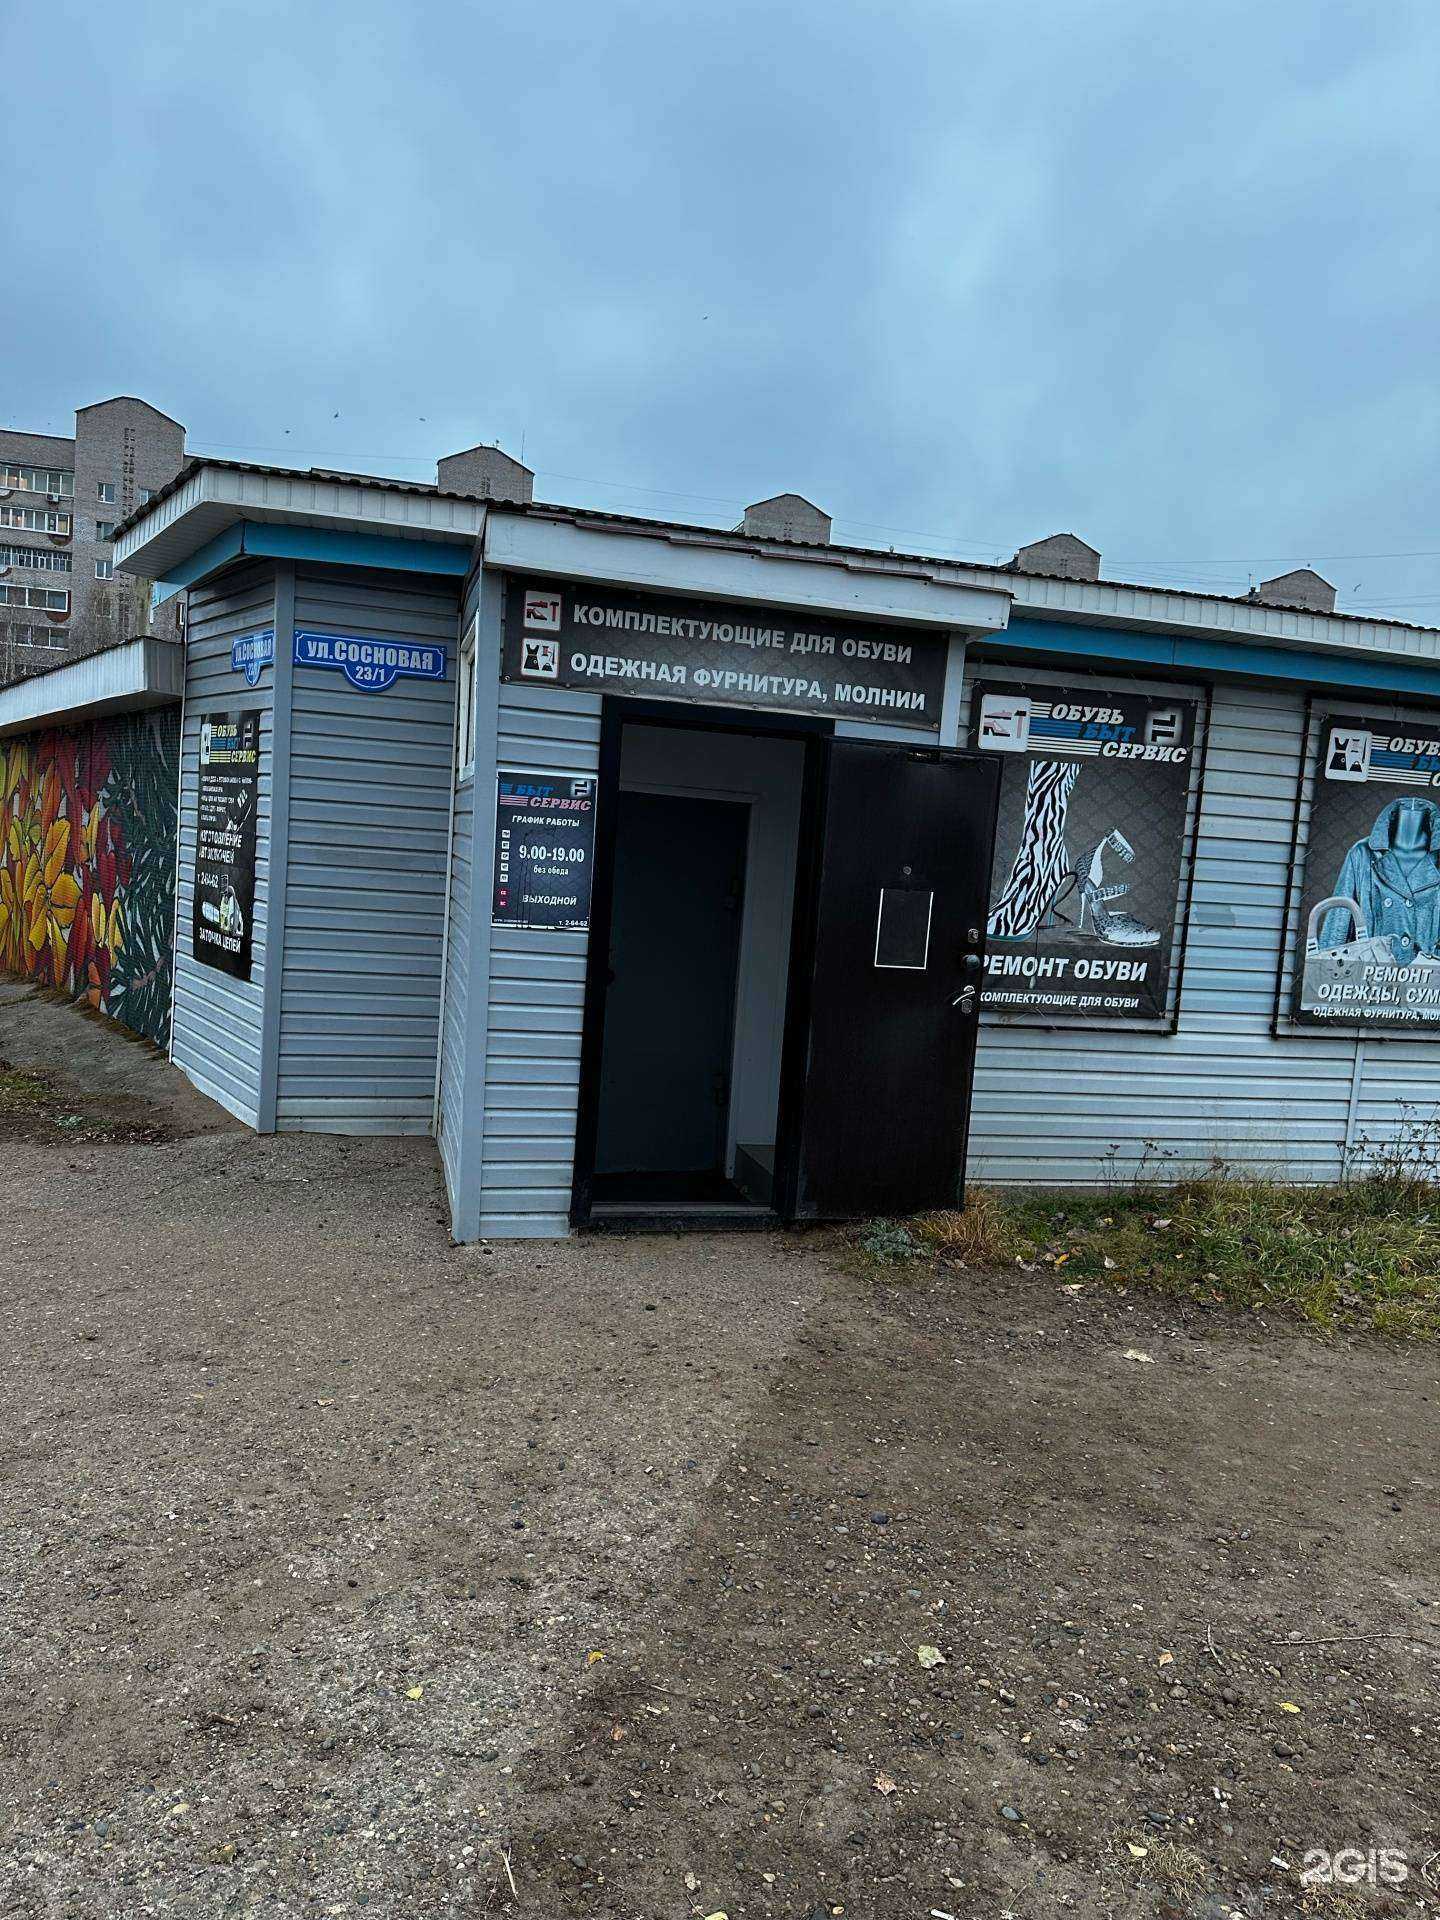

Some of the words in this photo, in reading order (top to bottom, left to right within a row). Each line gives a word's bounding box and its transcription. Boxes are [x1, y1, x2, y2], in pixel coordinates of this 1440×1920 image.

[573, 604, 785, 649] КОМПЛЕКТУЮЩИЕ
[790, 633, 836, 655] ДЛЯ
[842, 638, 912, 664] ОБУВИ
[355, 666, 385, 681] 23/1
[570, 653, 687, 684] ОДЕЖНАЯ
[693, 668, 828, 703] ФУРНИТУРА,
[834, 683, 926, 711] МОЛНИИ
[1052, 703, 1124, 725] ОБУВЬ
[1082, 722, 1136, 742] БЫТ
[1102, 741, 1188, 763] СЕРВИС
[1390, 737, 1440, 757] ОБУВ
[515, 783, 555, 796] БЫТ
[530, 796, 592, 811] СЕРВИС
[512, 815, 544, 825] ГРАФИК
[546, 817, 580, 827] РАБОТЫ
[519, 844, 585, 863] 9.00-19.00
[533, 865, 546, 874] без
[548, 866, 569, 876] обеда
[522, 894, 578, 906] ВЫХОДНОЙ
[1074, 959, 1148, 982] ОБУВИ
[1363, 966, 1433, 983] РЕМОНТ
[1079, 996, 1102, 1008] ДЛЯ
[1104, 997, 1140, 1009] ОБУВИ
[1318, 983, 1401, 1005] ОДЕЖДЫ,
[1313, 1006, 1361, 1018] ОДЕЖНАЯ
[1364, 1008, 1420, 1021] ФУРНИТУРА,
